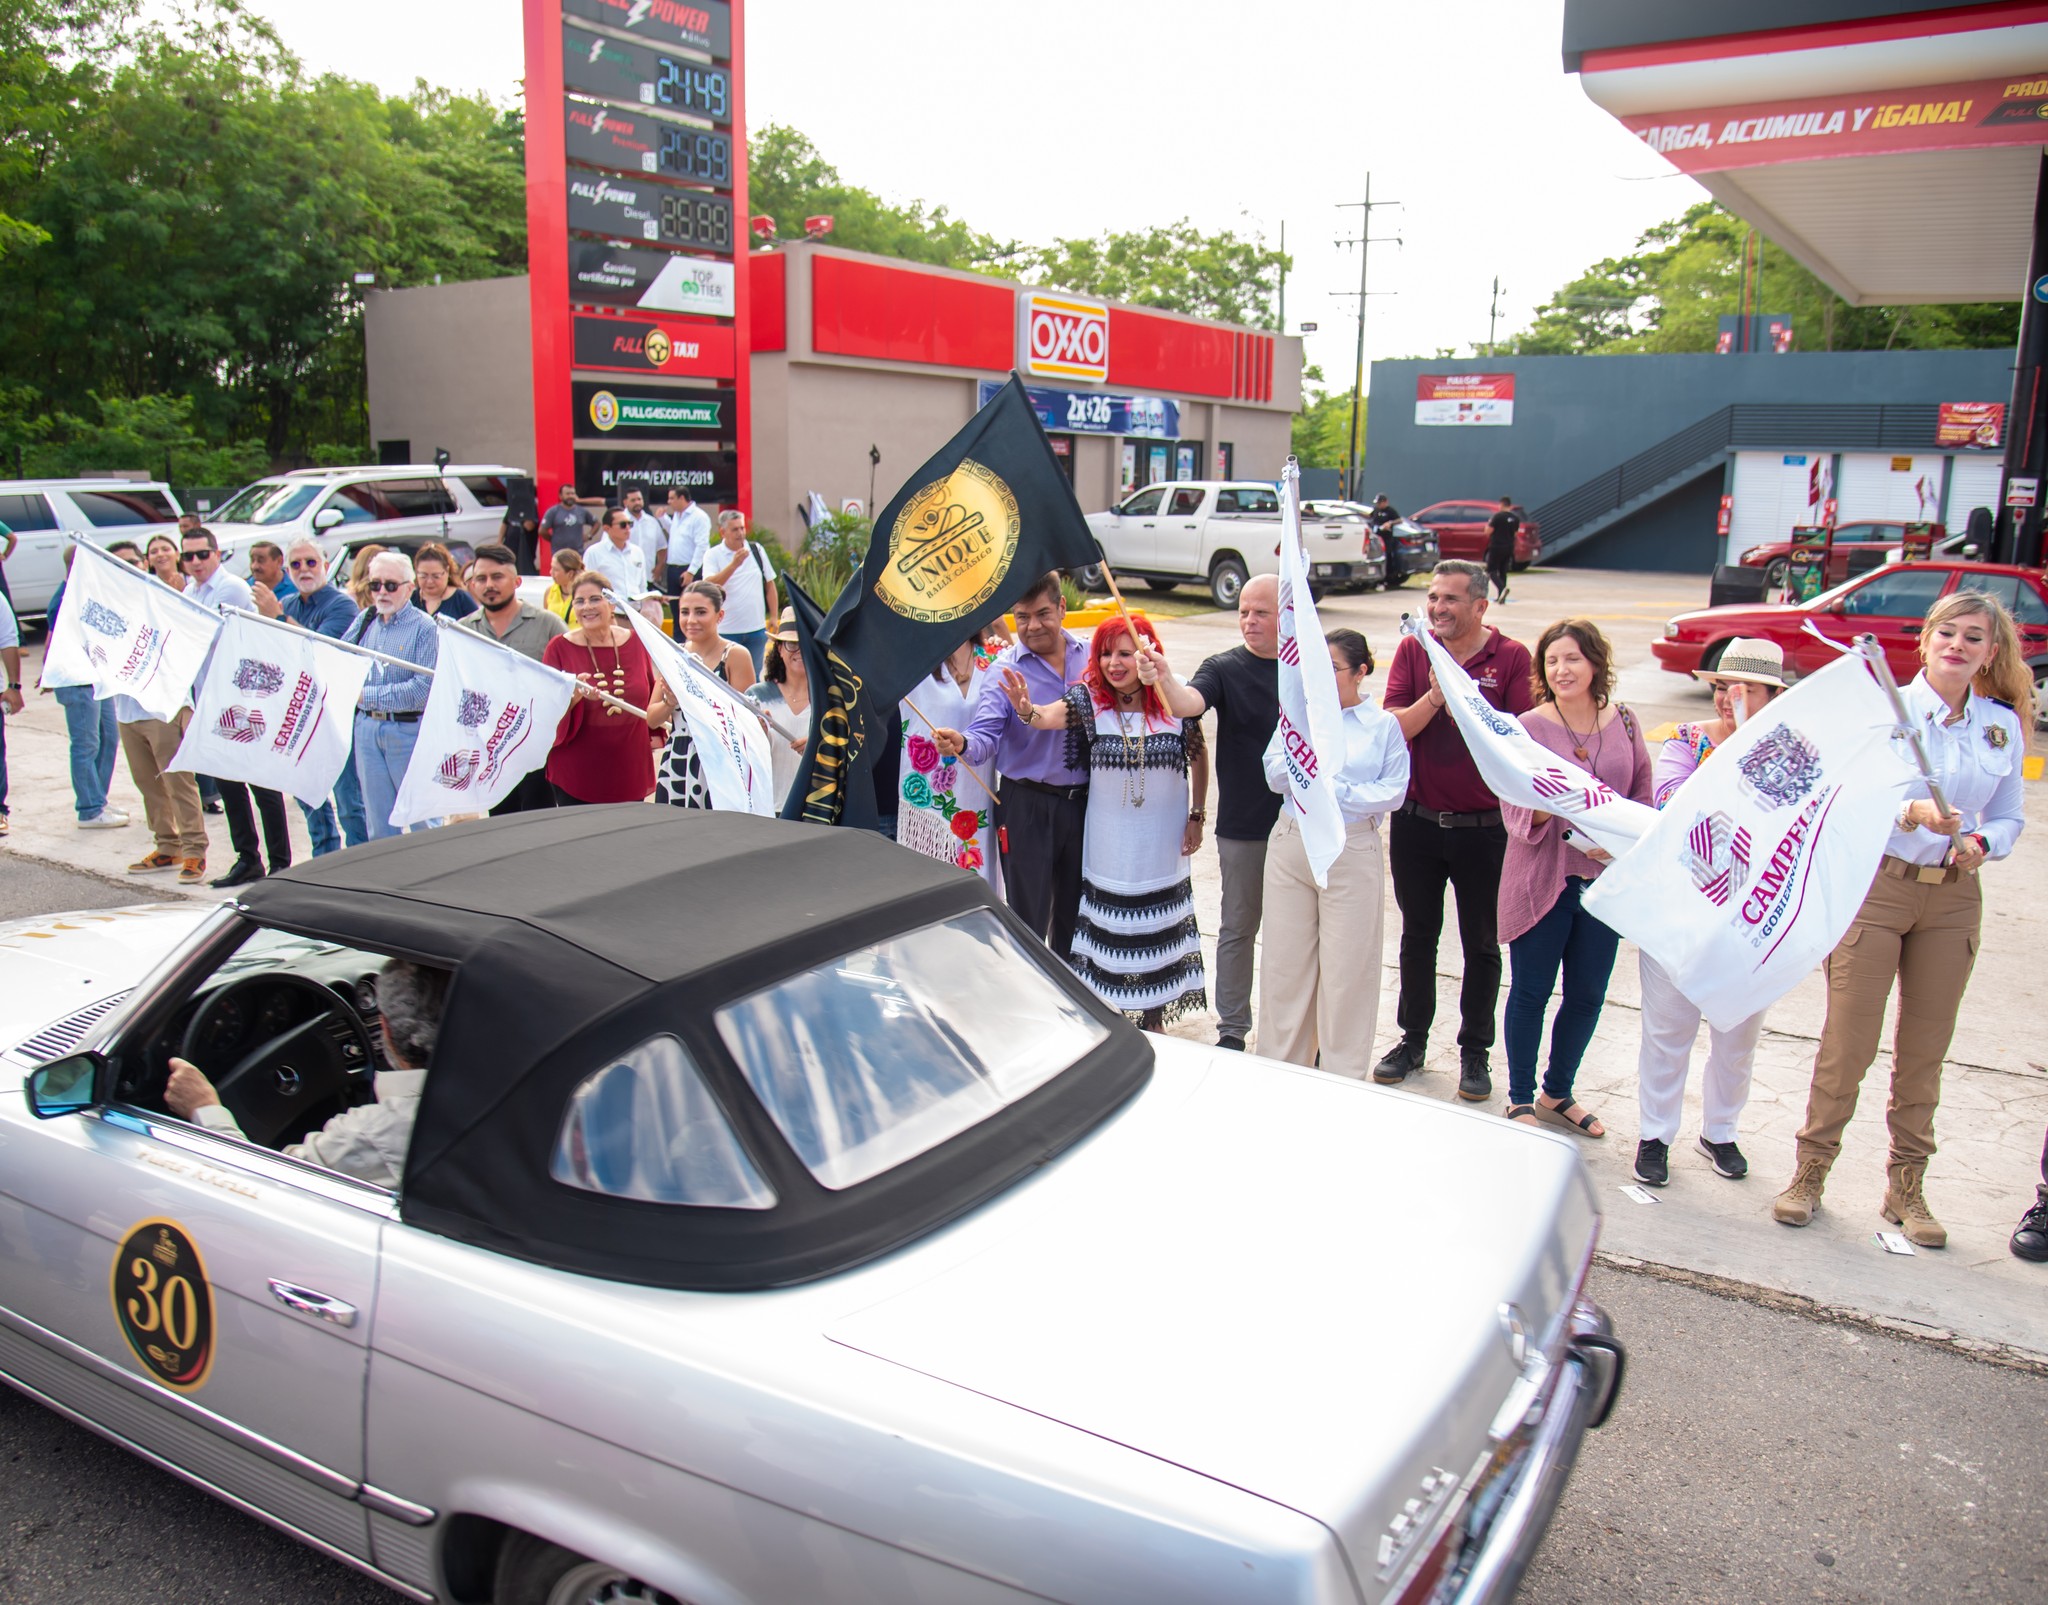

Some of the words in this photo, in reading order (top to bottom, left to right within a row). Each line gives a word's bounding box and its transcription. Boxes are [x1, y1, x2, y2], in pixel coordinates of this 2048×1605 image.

[650, 0, 711, 33] POWER
[2002, 80, 2048, 98] PRO
[569, 110, 594, 127] FULL
[602, 118, 635, 136] POWER
[1716, 109, 1845, 145] ACUMULA
[1851, 107, 1874, 132] Y
[571, 181, 596, 198] FULL
[604, 188, 637, 206] POWER
[577, 271, 620, 286] certificada
[602, 261, 637, 276] Gasolina
[692, 269, 713, 285] TOP
[701, 283, 723, 298] TIER
[613, 336, 644, 354] FULL
[672, 341, 700, 359] TAXI
[1031, 313, 1105, 364] OXXO
[907, 525, 995, 592] UNIQUE
[925, 574, 954, 600] RALLY
[273, 670, 313, 748] CAMPECHE
[127, 1256, 198, 1351] 30
